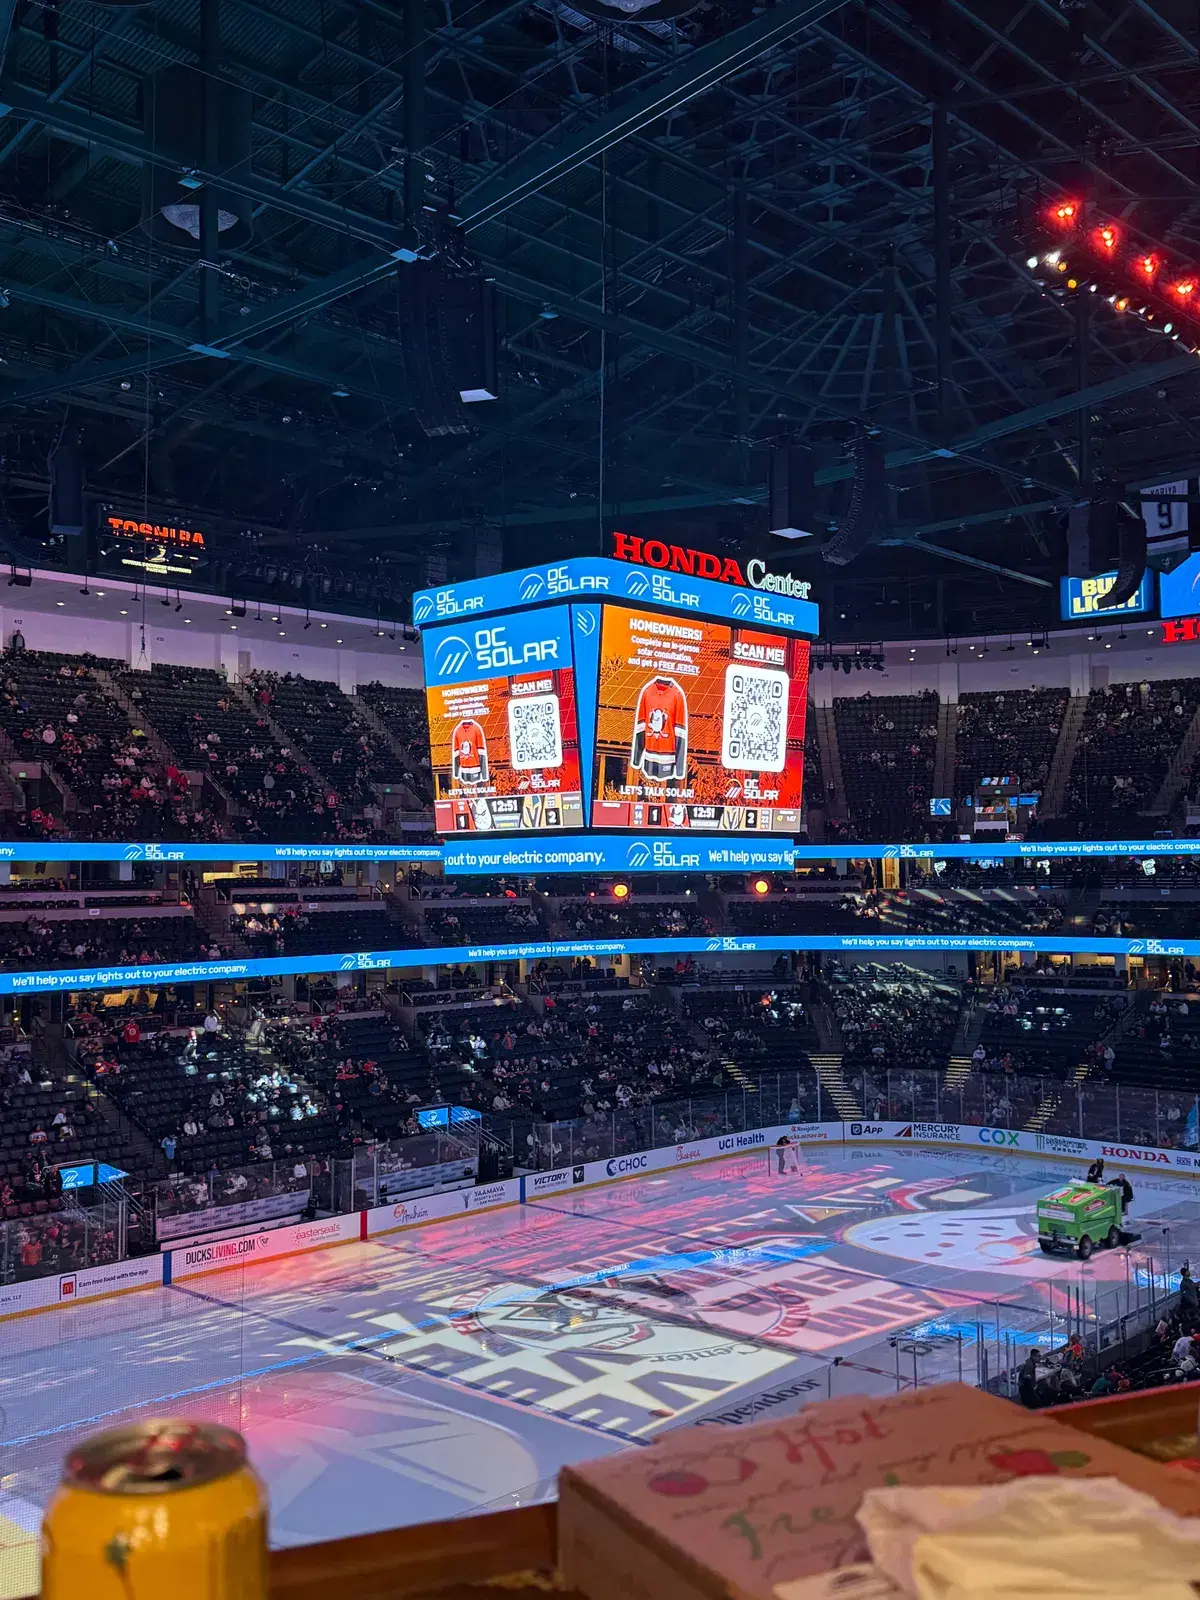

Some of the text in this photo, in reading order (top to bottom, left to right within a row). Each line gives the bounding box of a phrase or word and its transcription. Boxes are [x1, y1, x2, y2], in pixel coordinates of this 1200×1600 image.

[1158, 502, 1173, 530] 9
[613, 532, 811, 600] HONDA Center
[548, 566, 568, 581] OC
[548, 576, 609, 595] SOLAR
[652, 575, 672, 589] OC
[1082, 577, 1118, 597] BU
[437, 590, 455, 603] OC
[652, 588, 699, 607] SOLAR
[754, 596, 770, 609] OC
[437, 597, 484, 616] SOLAR
[754, 609, 794, 625] SOLAR
[629, 618, 702, 641] HOMEOWNERS!
[1161, 618, 1200, 643] H
[475, 626, 506, 650] OC
[476, 639, 559, 670] SOLAR
[734, 642, 785, 663] SCAN ME!
[659, 661, 675, 670] FREE
[511, 682, 537, 694] SCAN
[531, 780, 561, 789] SOLAR
[744, 778, 759, 789] OC
[620, 785, 694, 799] LET'S TALK SOLAR!
[744, 790, 778, 800] SOLAR
[492, 799, 518, 813] 12:51
[692, 807, 715, 819] 12:51
[460, 816, 466, 828] 1
[548, 811, 557, 824] 2
[651, 808, 659, 823] 1
[747, 812, 755, 824] 2
[145, 844, 161, 852] OC
[292, 848, 307, 857] help
[322, 849, 333, 857] say
[334, 848, 353, 858] lights
[389, 848, 412, 856] electric
[653, 841, 672, 854] OC
[1038, 845, 1053, 854] help
[1082, 844, 1104, 854] lights
[145, 852, 184, 860] SOLAR
[448, 853, 464, 866] out
[466, 853, 477, 866] to
[478, 855, 501, 868] your
[503, 850, 541, 864] electric
[545, 852, 606, 865] company.
[653, 855, 699, 867] SOLAR
[708, 850, 729, 862] We'll
[730, 850, 749, 864] help
[751, 853, 766, 864] you
[768, 853, 782, 865] say
[468, 949, 482, 957] We'll
[482, 949, 495, 957] help
[496, 949, 507, 957] you
[508, 948, 518, 957] say
[518, 947, 535, 956] lights
[555, 945, 570, 954] your
[570, 943, 595, 952] electric
[595, 943, 626, 952] company.
[842, 938, 857, 946] We'll
[858, 938, 874, 947] help
[876, 939, 890, 947] you
[890, 939, 903, 947] say
[904, 938, 926, 947] lights
[927, 938, 940, 946] out
[950, 939, 967, 947] your
[968, 938, 997, 946] electric
[998, 939, 1035, 948] company.
[357, 953, 372, 961] OC
[1147, 946, 1184, 955] SOLAR
[357, 959, 391, 968] SOLAR
[12, 964, 248, 987] We'll help you say lights out to your electric company.
[913, 1124, 960, 1133] MERCURY
[719, 1132, 765, 1150] UCI Health
[913, 1132, 961, 1141] INSURANCE
[979, 1127, 1020, 1147] COX
[1101, 1146, 1171, 1164] HONDA
[618, 1155, 648, 1172] CHOC
[401, 1205, 428, 1223] Anaheim
[295, 1223, 340, 1241] easterseals
[186, 1239, 255, 1264] DUCKSLIVING.COM
[79, 1279, 91, 1288] Earn
[104, 1275, 116, 1284] food
[117, 1273, 128, 1281] with
[138, 1269, 149, 1278] app
[649, 1343, 761, 1364] Center
